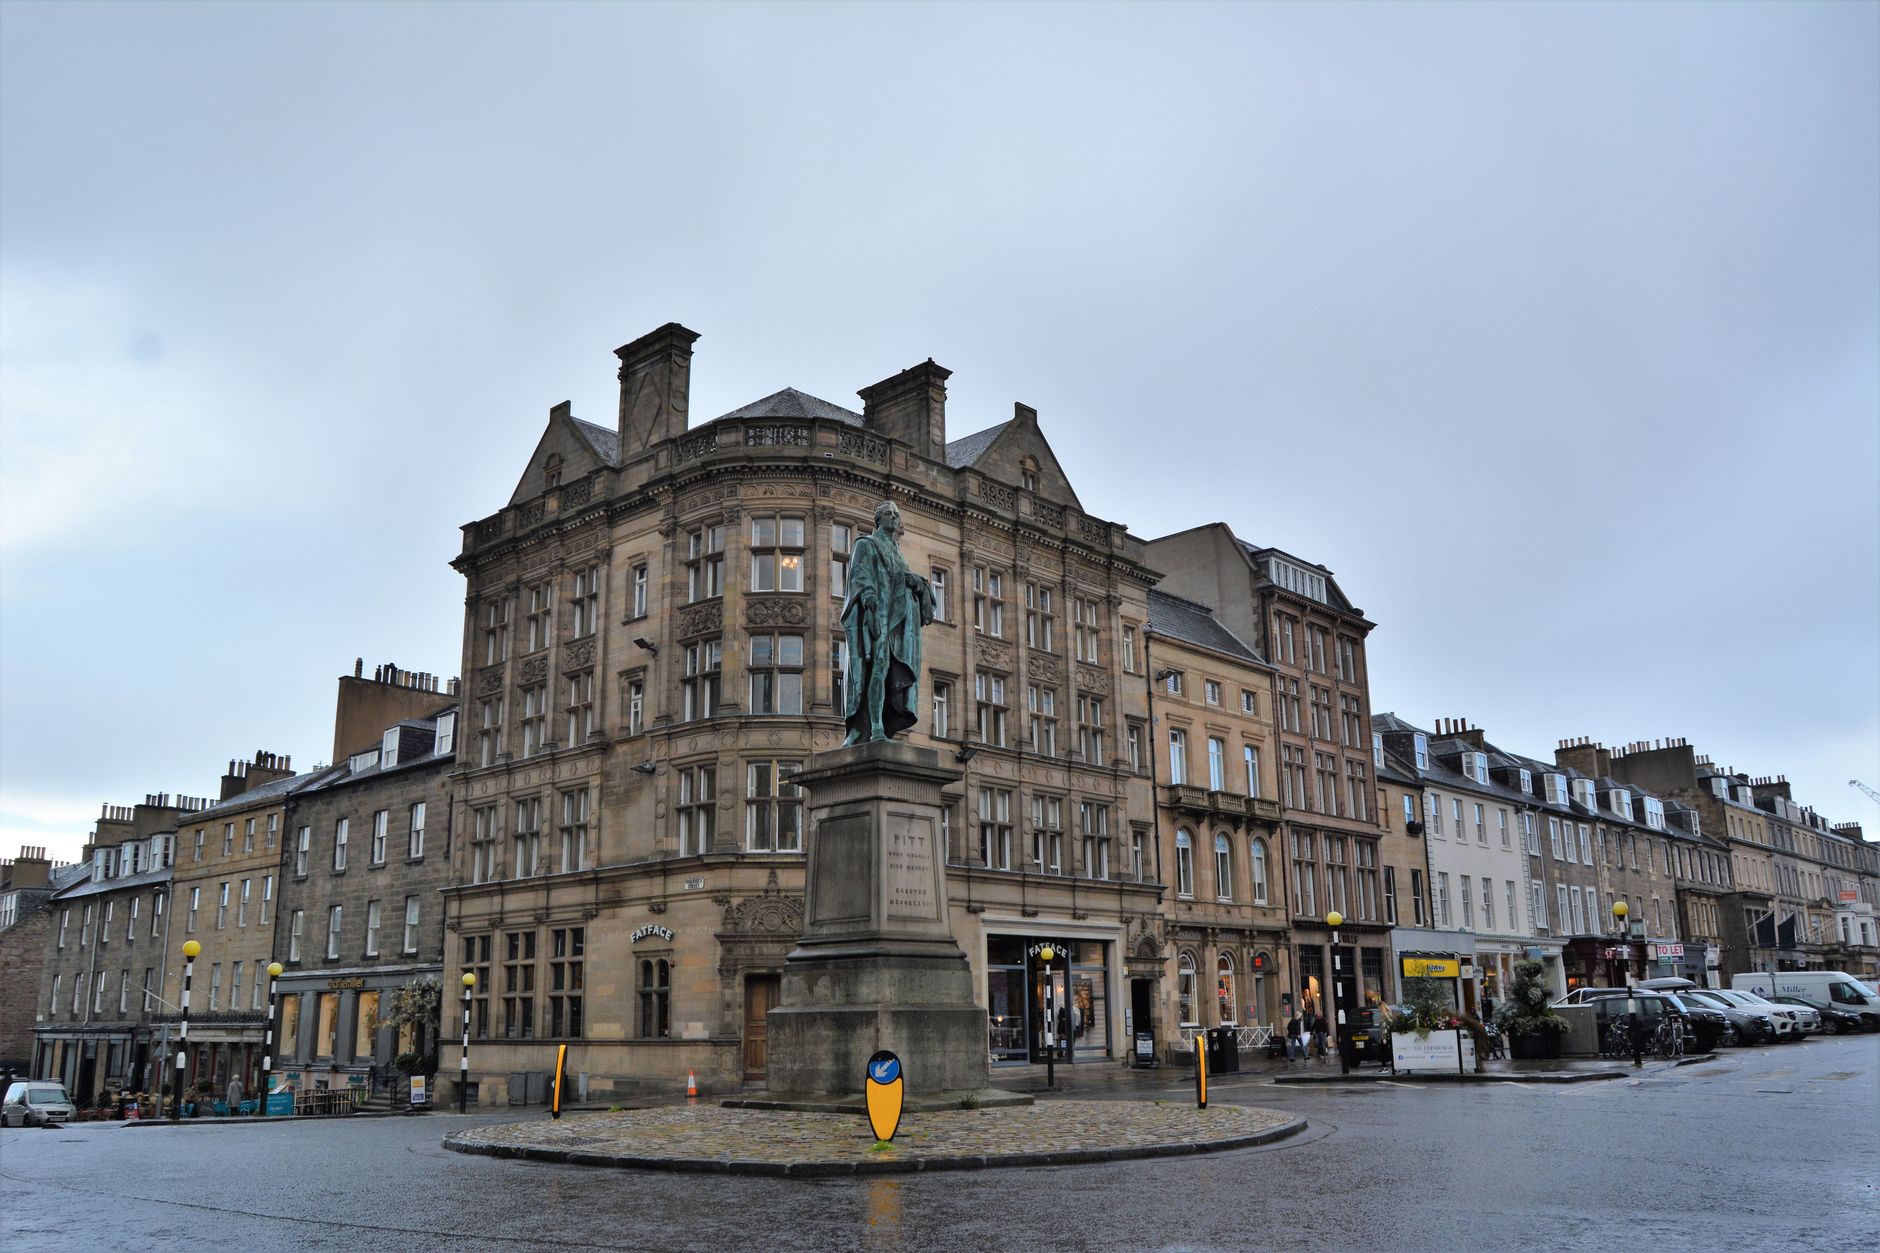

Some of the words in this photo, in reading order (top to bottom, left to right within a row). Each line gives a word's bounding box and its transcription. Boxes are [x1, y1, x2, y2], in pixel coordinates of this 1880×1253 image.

[893, 834, 926, 847] PITT
[630, 924, 673, 944] FATFACE
[1657, 946, 1668, 955] TO
[1670, 945, 1683, 955] LET
[1781, 985, 1807, 993] Miller
